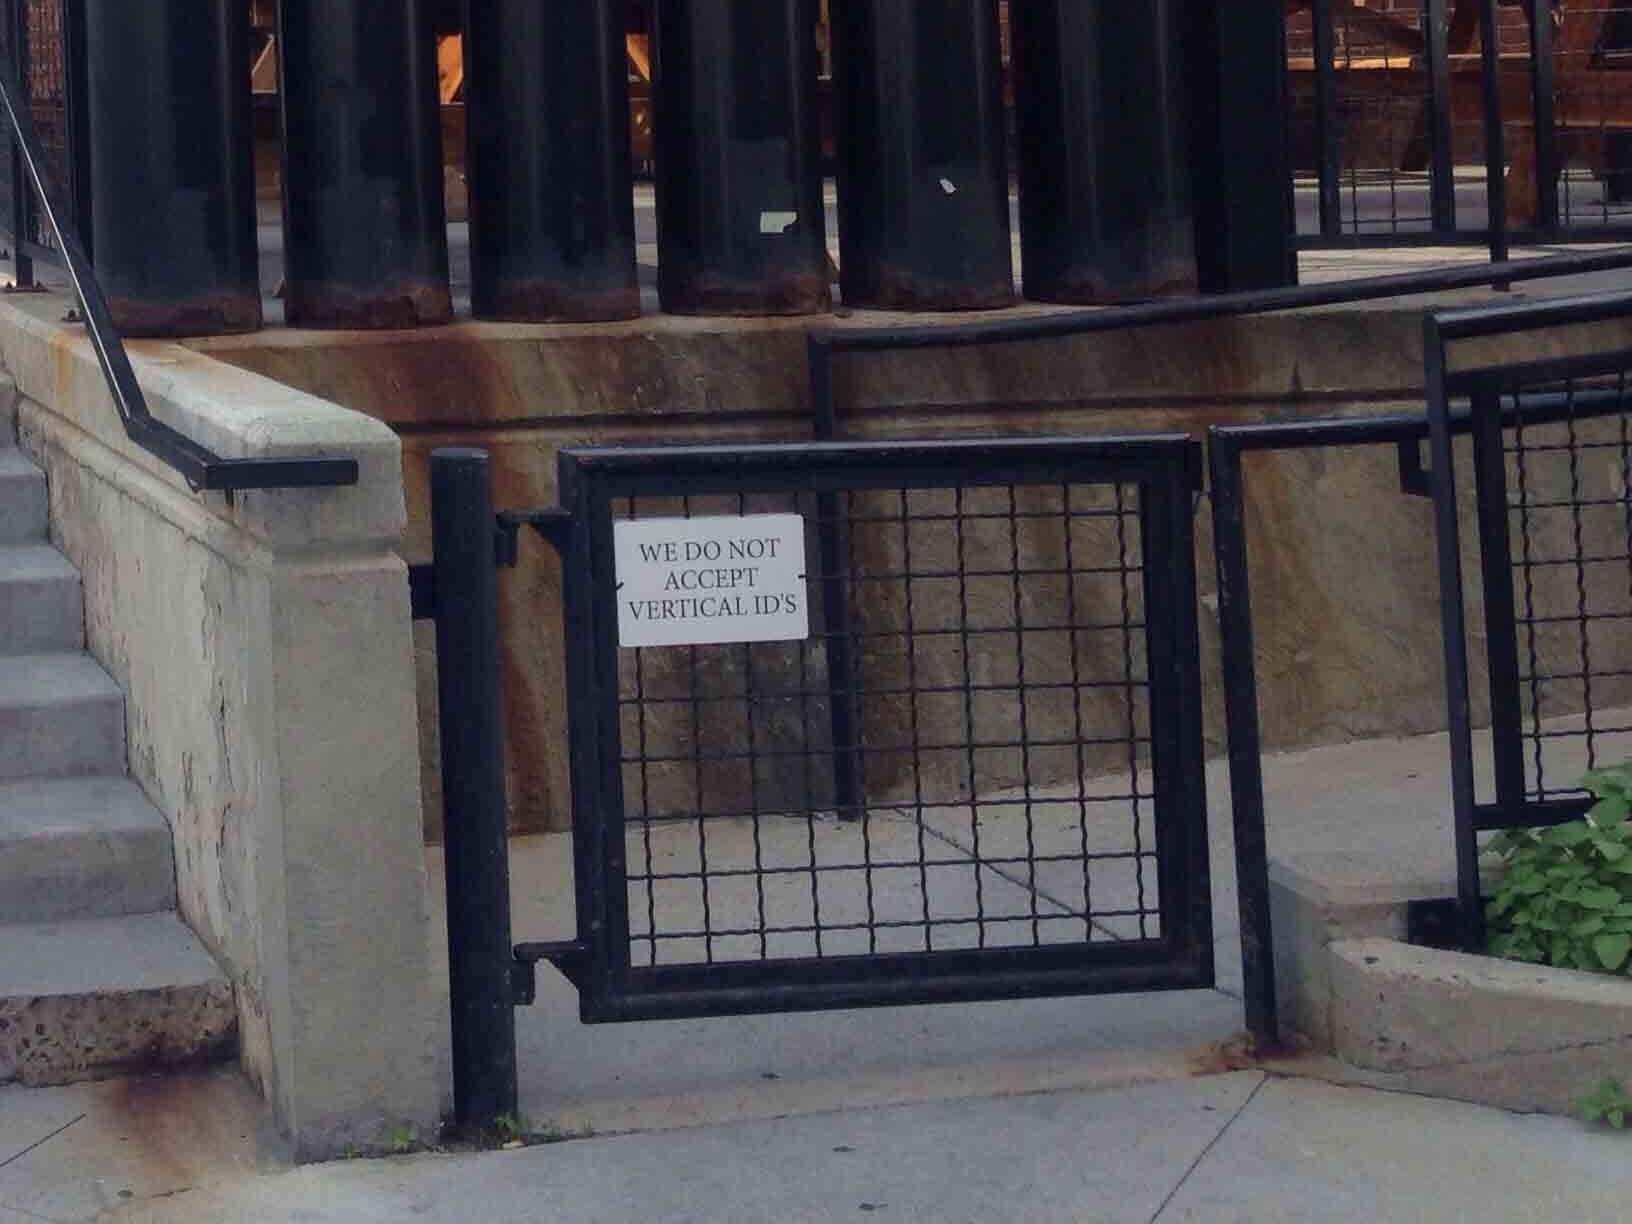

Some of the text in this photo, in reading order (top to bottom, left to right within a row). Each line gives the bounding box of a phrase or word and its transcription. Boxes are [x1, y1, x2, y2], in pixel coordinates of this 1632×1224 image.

[639, 538, 780, 563] WE DO NOT
[664, 567, 758, 590] ACCEPT
[628, 593, 797, 621] VERTICAL ID'S
